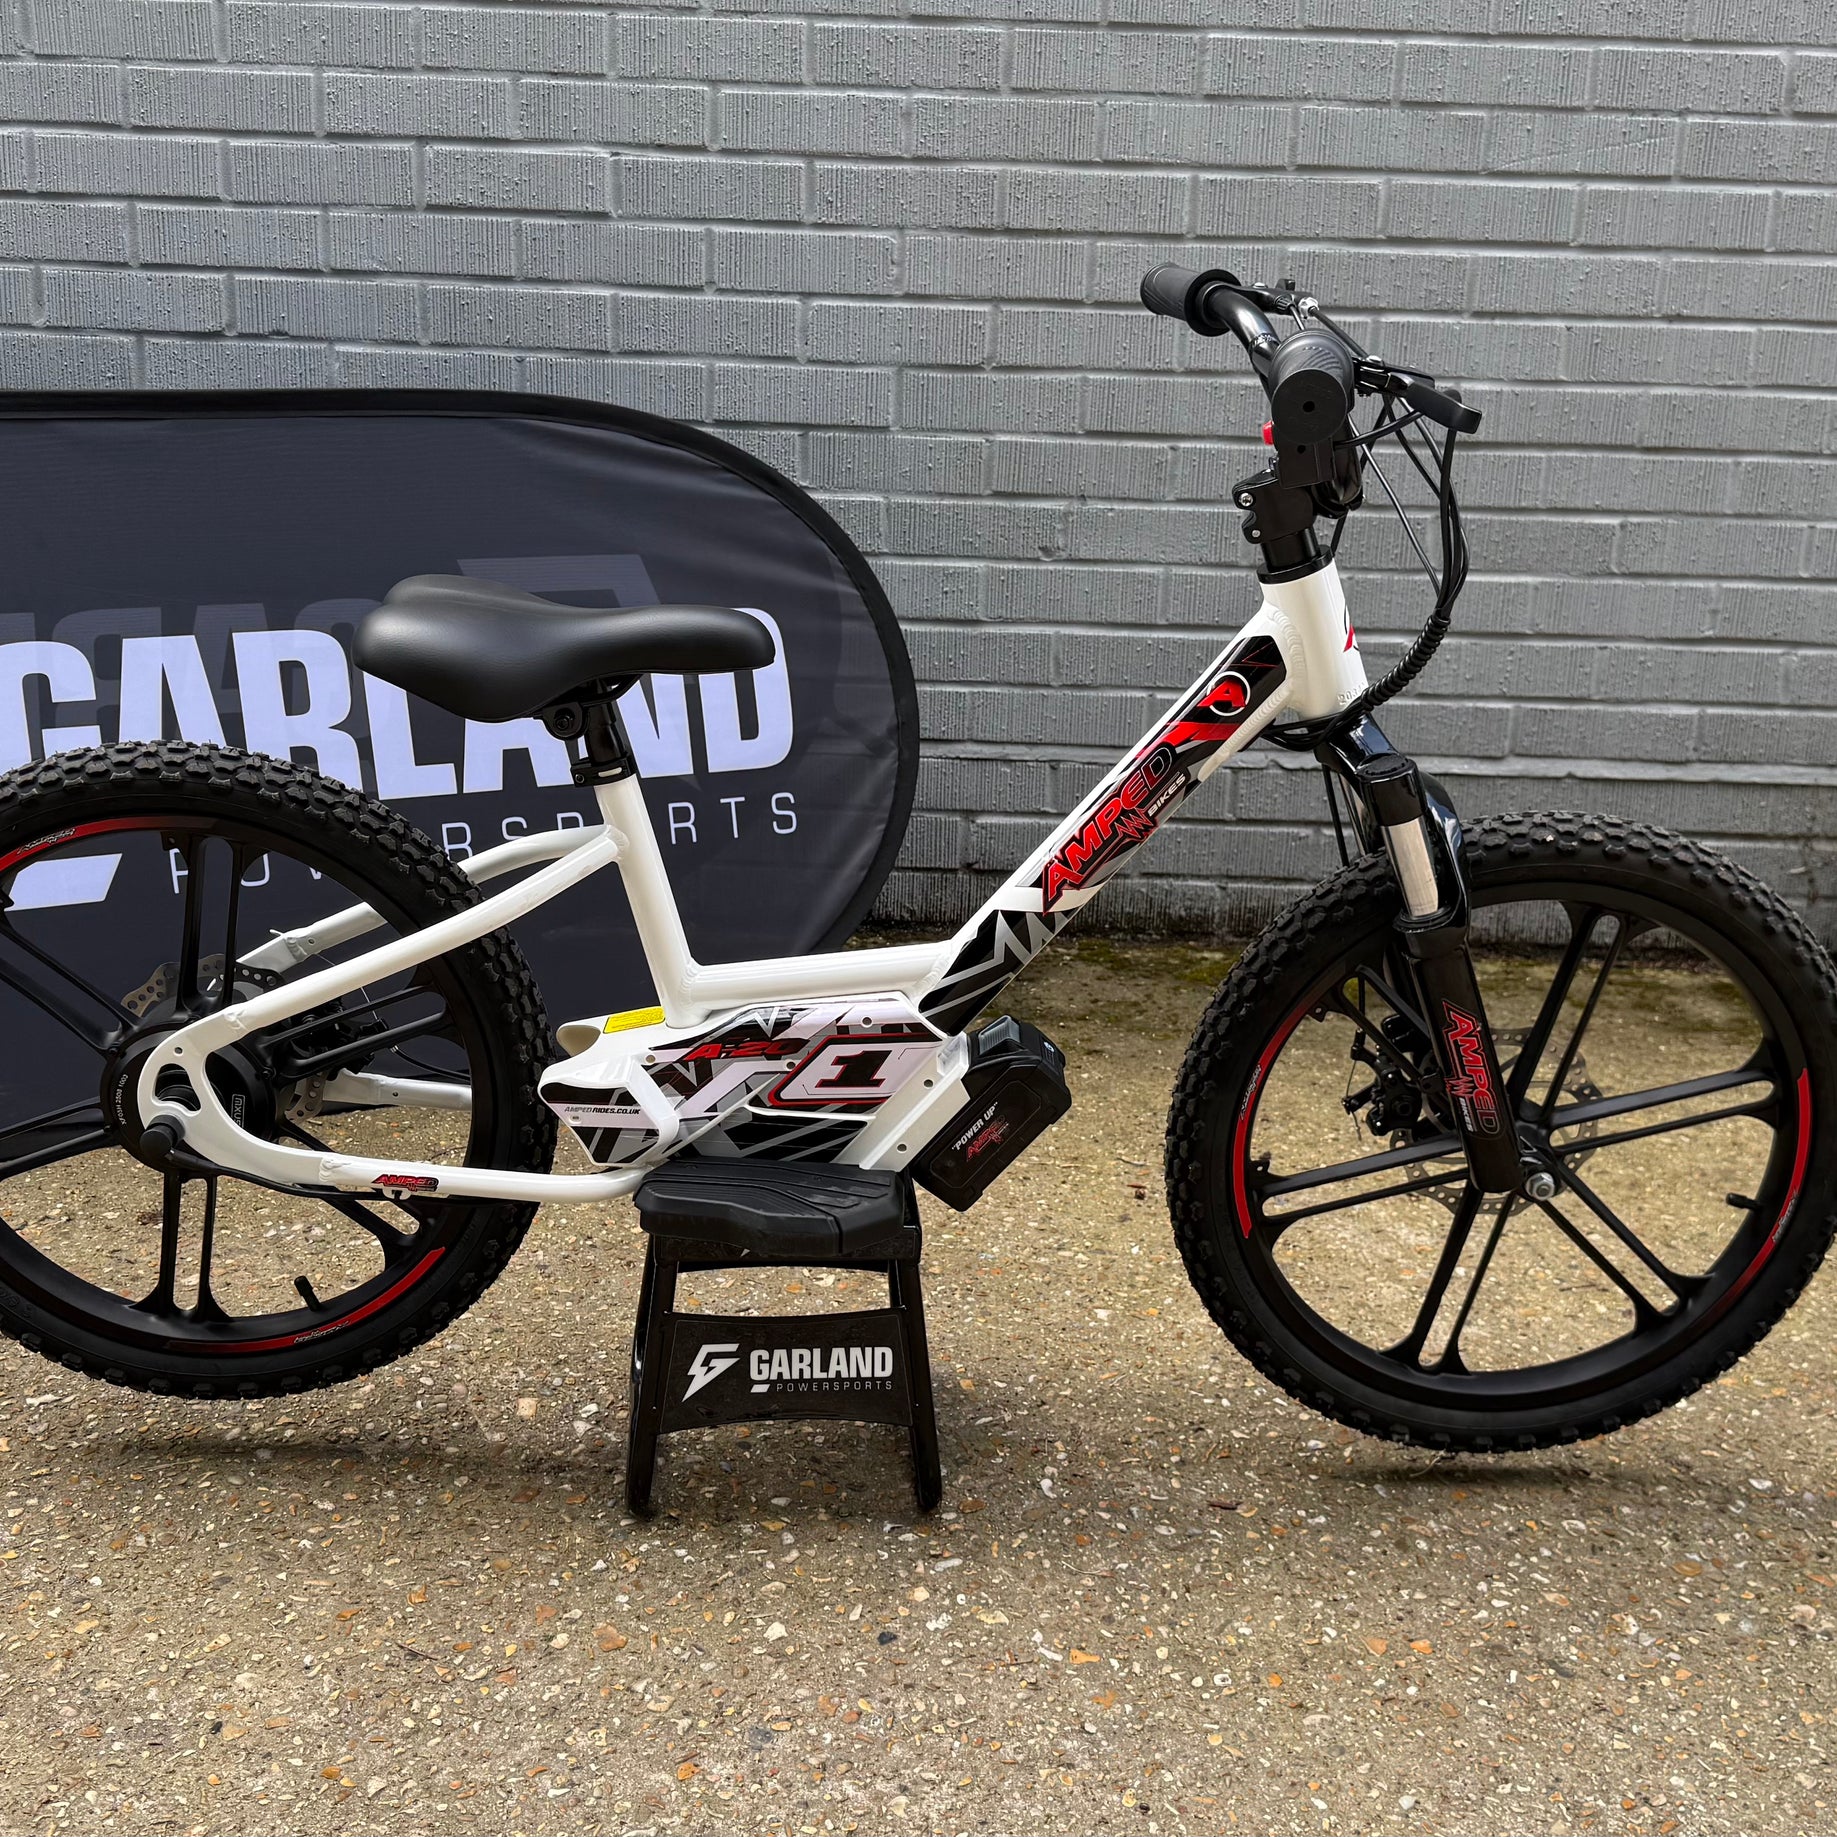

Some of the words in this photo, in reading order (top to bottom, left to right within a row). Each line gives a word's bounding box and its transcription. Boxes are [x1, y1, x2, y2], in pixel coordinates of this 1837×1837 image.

[1147, 773, 1186, 817] BIKES
[1047, 745, 1174, 902] AMPED
[814, 1049, 892, 1088] 1
[1448, 1008, 1501, 1135] AMPED
[749, 1346, 894, 1381] GARLAND
[776, 1380, 893, 1393] POWERSPORTS
